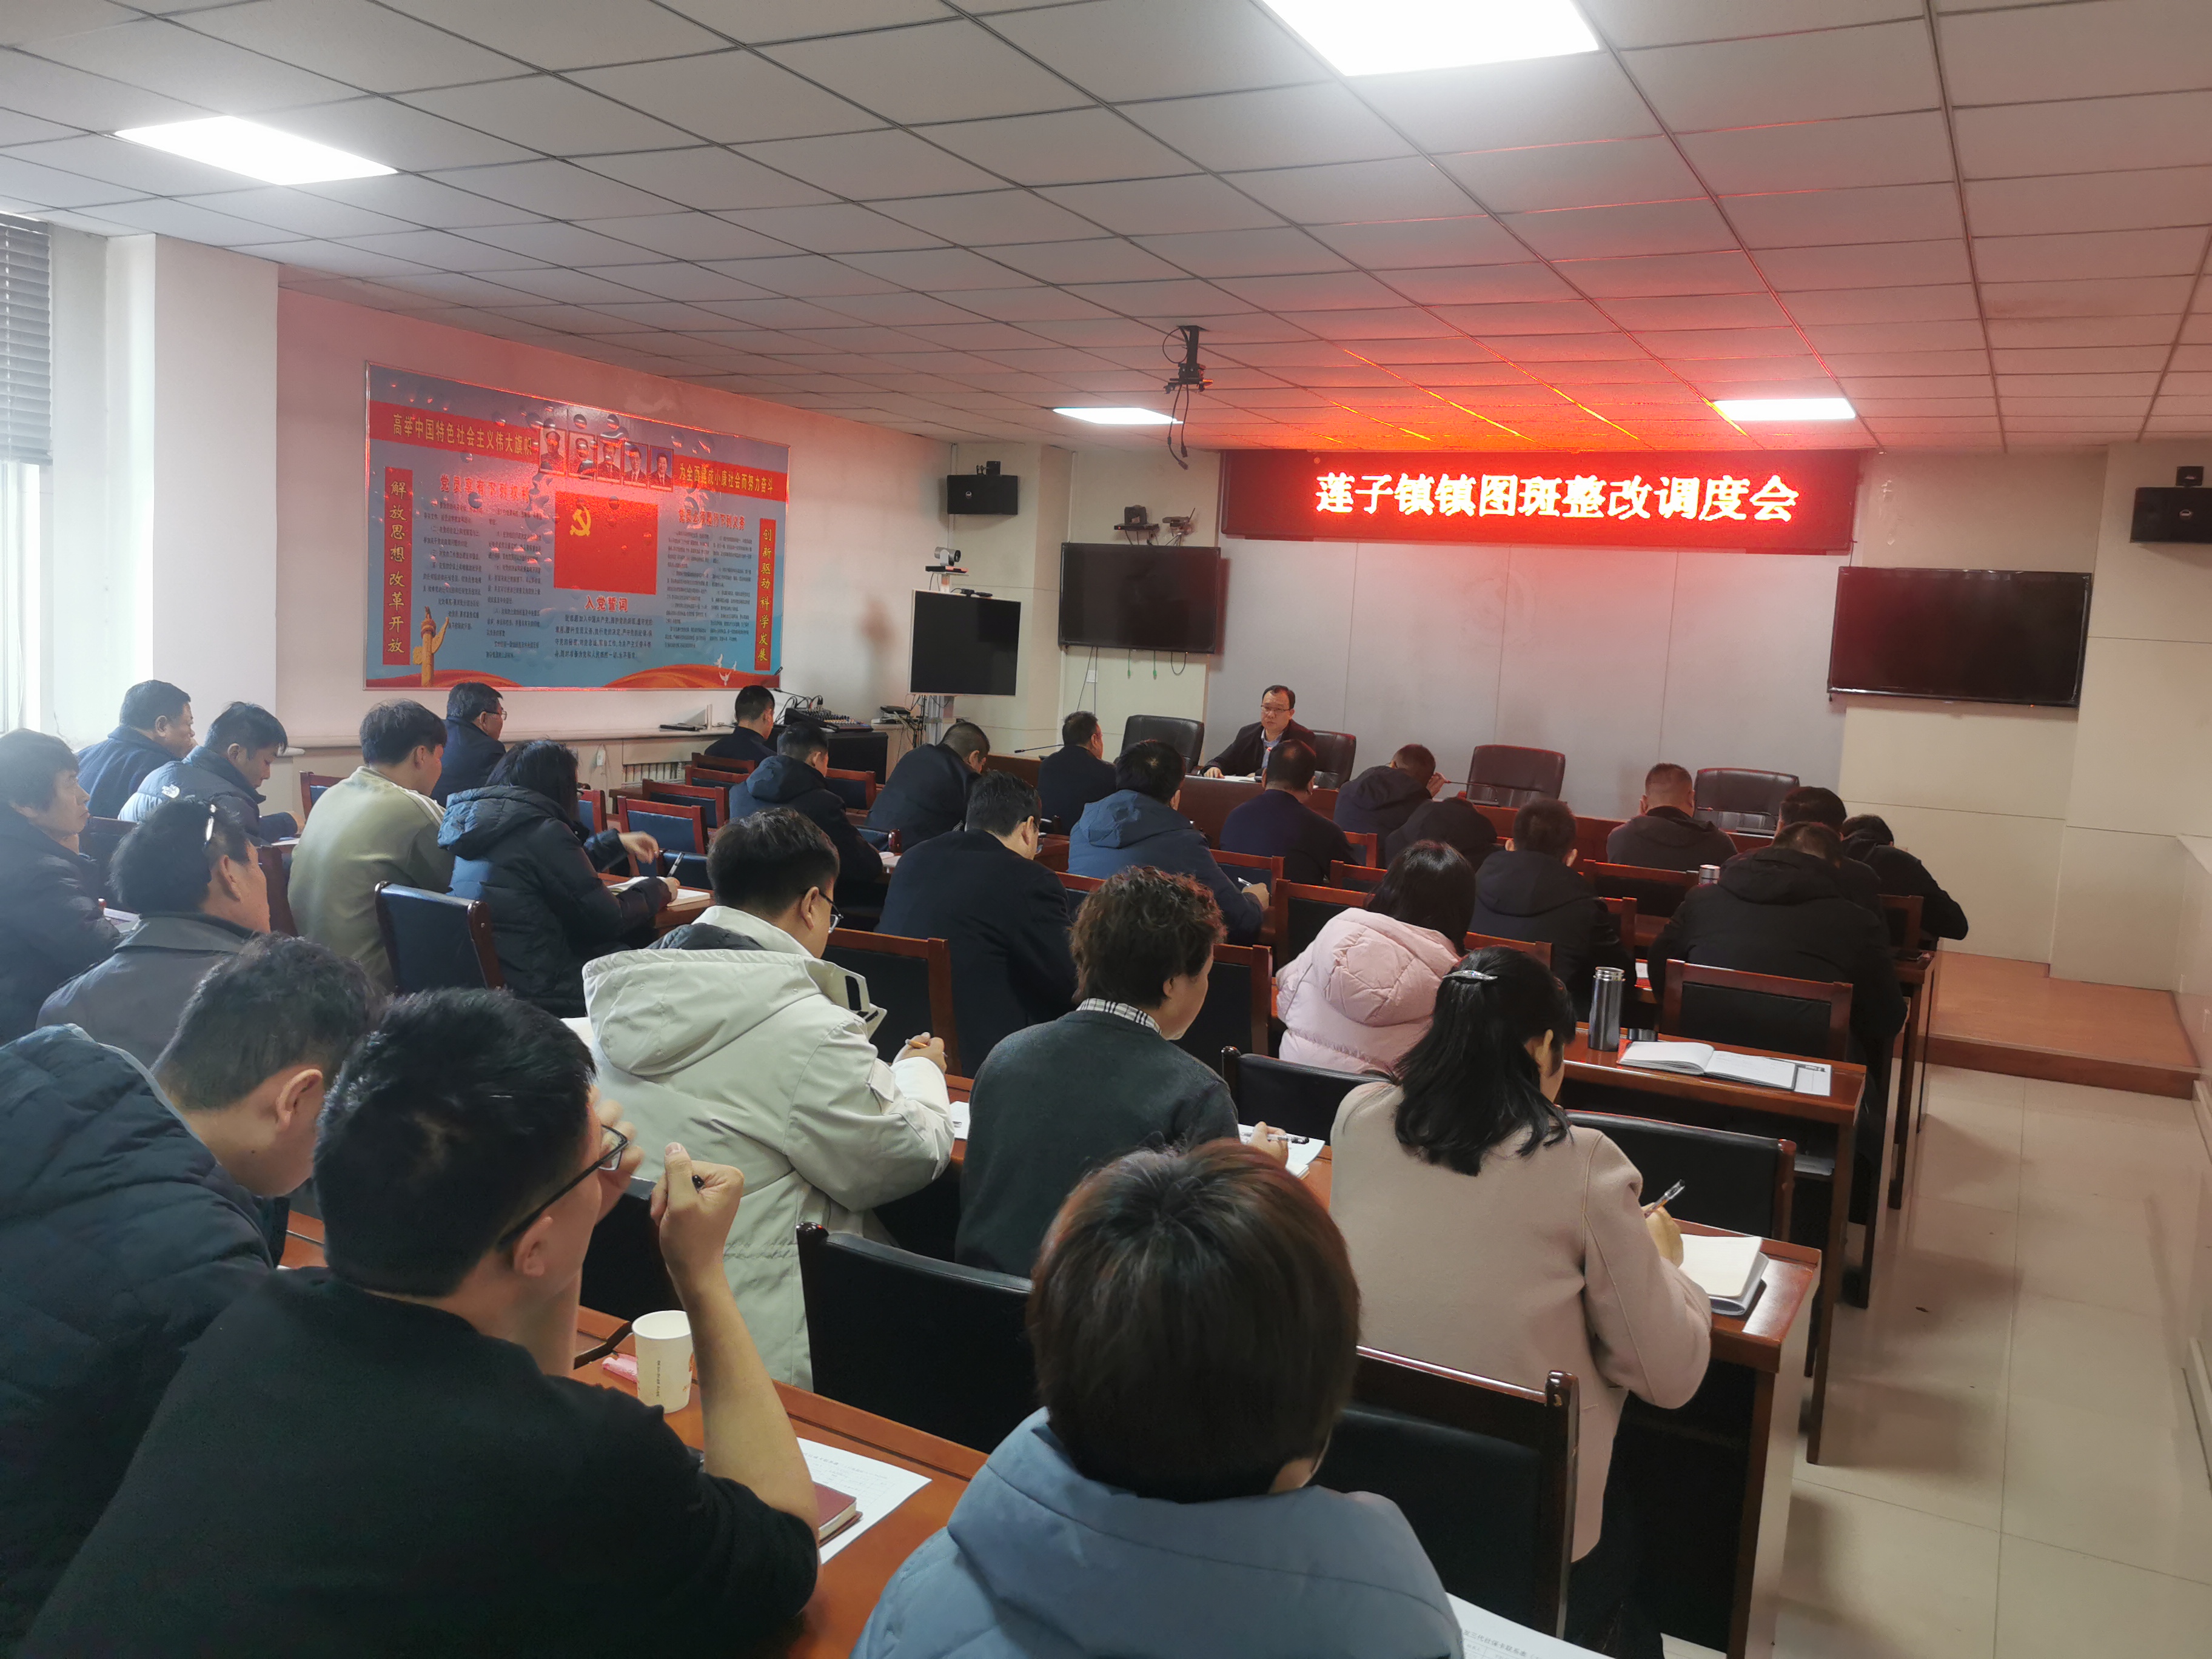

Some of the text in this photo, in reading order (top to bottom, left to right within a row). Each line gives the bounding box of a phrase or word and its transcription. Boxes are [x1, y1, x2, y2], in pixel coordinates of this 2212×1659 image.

[393, 413, 533, 456] 高举中国特色社会主义伟大旗帜
[679, 463, 774, 494] 为全面建成小康社会而努力奋斗
[1315, 472, 1800, 523] 莲子镇镇图斑整改调度会
[585, 595, 629, 613] 入党誓词
